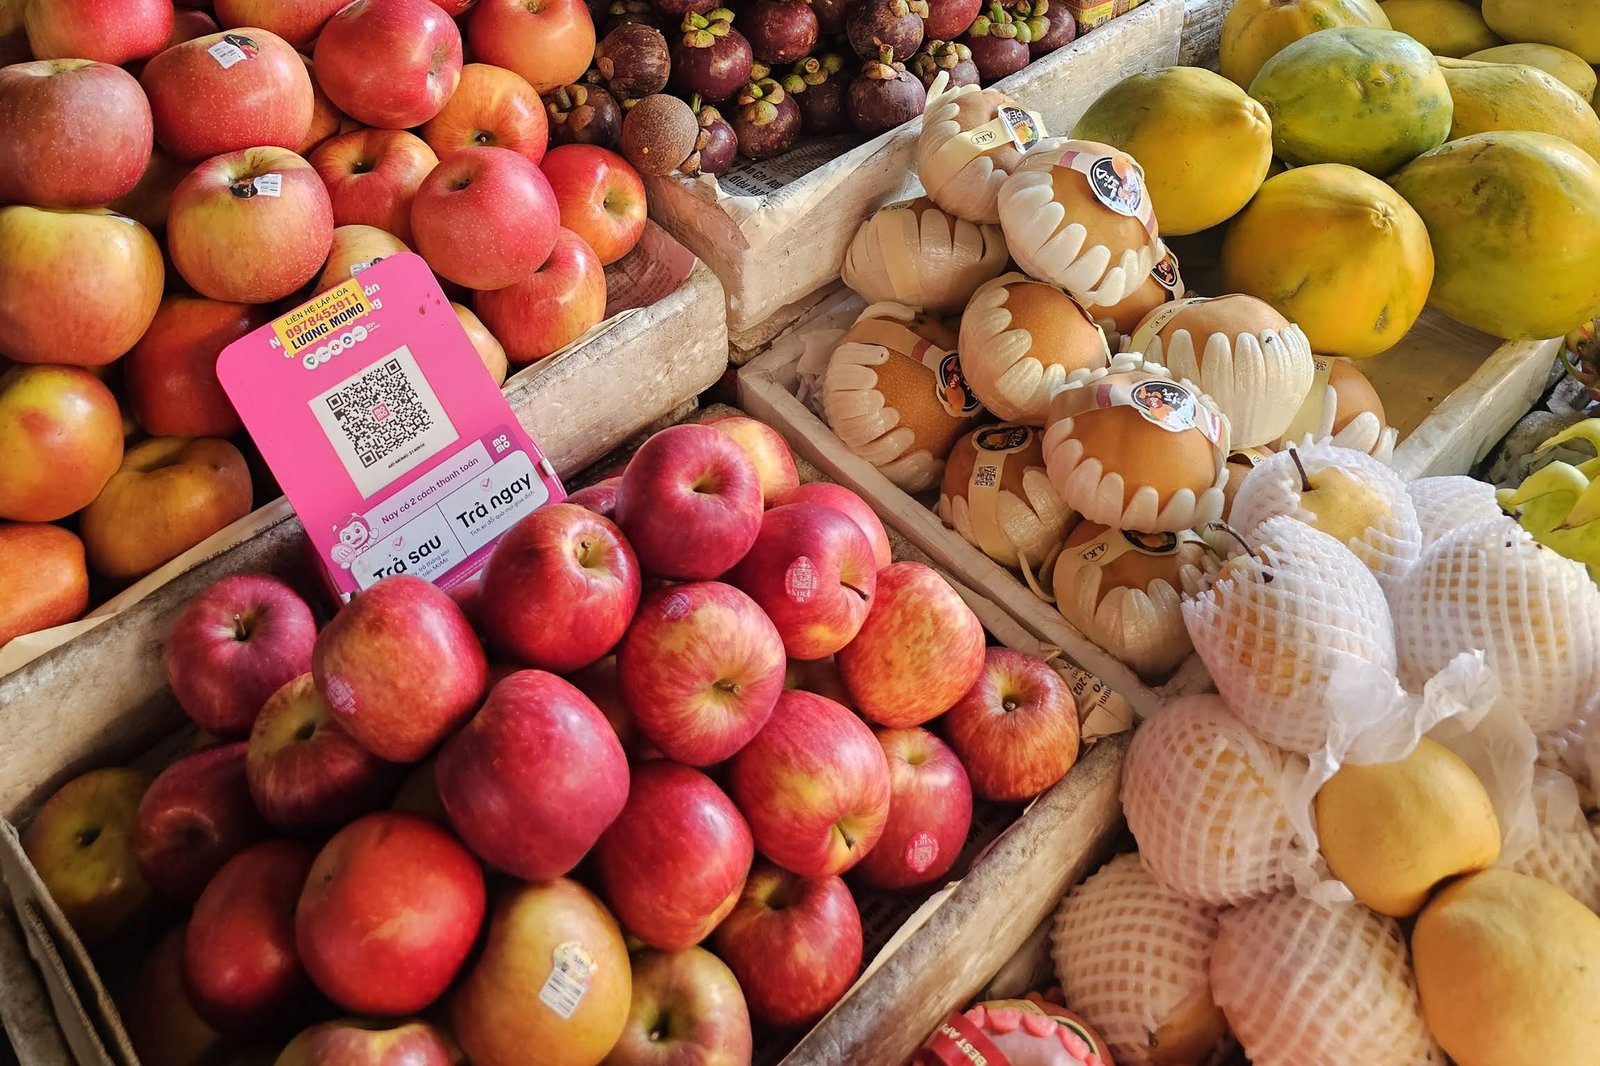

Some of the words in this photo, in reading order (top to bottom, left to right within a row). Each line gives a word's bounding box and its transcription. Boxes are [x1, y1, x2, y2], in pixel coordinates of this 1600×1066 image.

[285, 311, 304, 326] LIÊN
[305, 305, 316, 316] HỆ
[332, 287, 349, 301] LOA
[285, 292, 359, 339] 0978453911
[291, 323, 329, 350] LƯƠNG
[328, 302, 365, 329] MOMO
[381, 510, 399, 525] Nay
[400, 502, 410, 513] có
[410, 497, 417, 506] 2
[416, 485, 437, 502] cách
[436, 470, 460, 488] thanh
[459, 458, 479, 473] toán
[456, 501, 489, 528] Trả
[490, 473, 531, 510] ngay
[373, 557, 408, 579] Trả
[408, 535, 442, 565] sau
[956, 1038, 988, 1066] BEST
